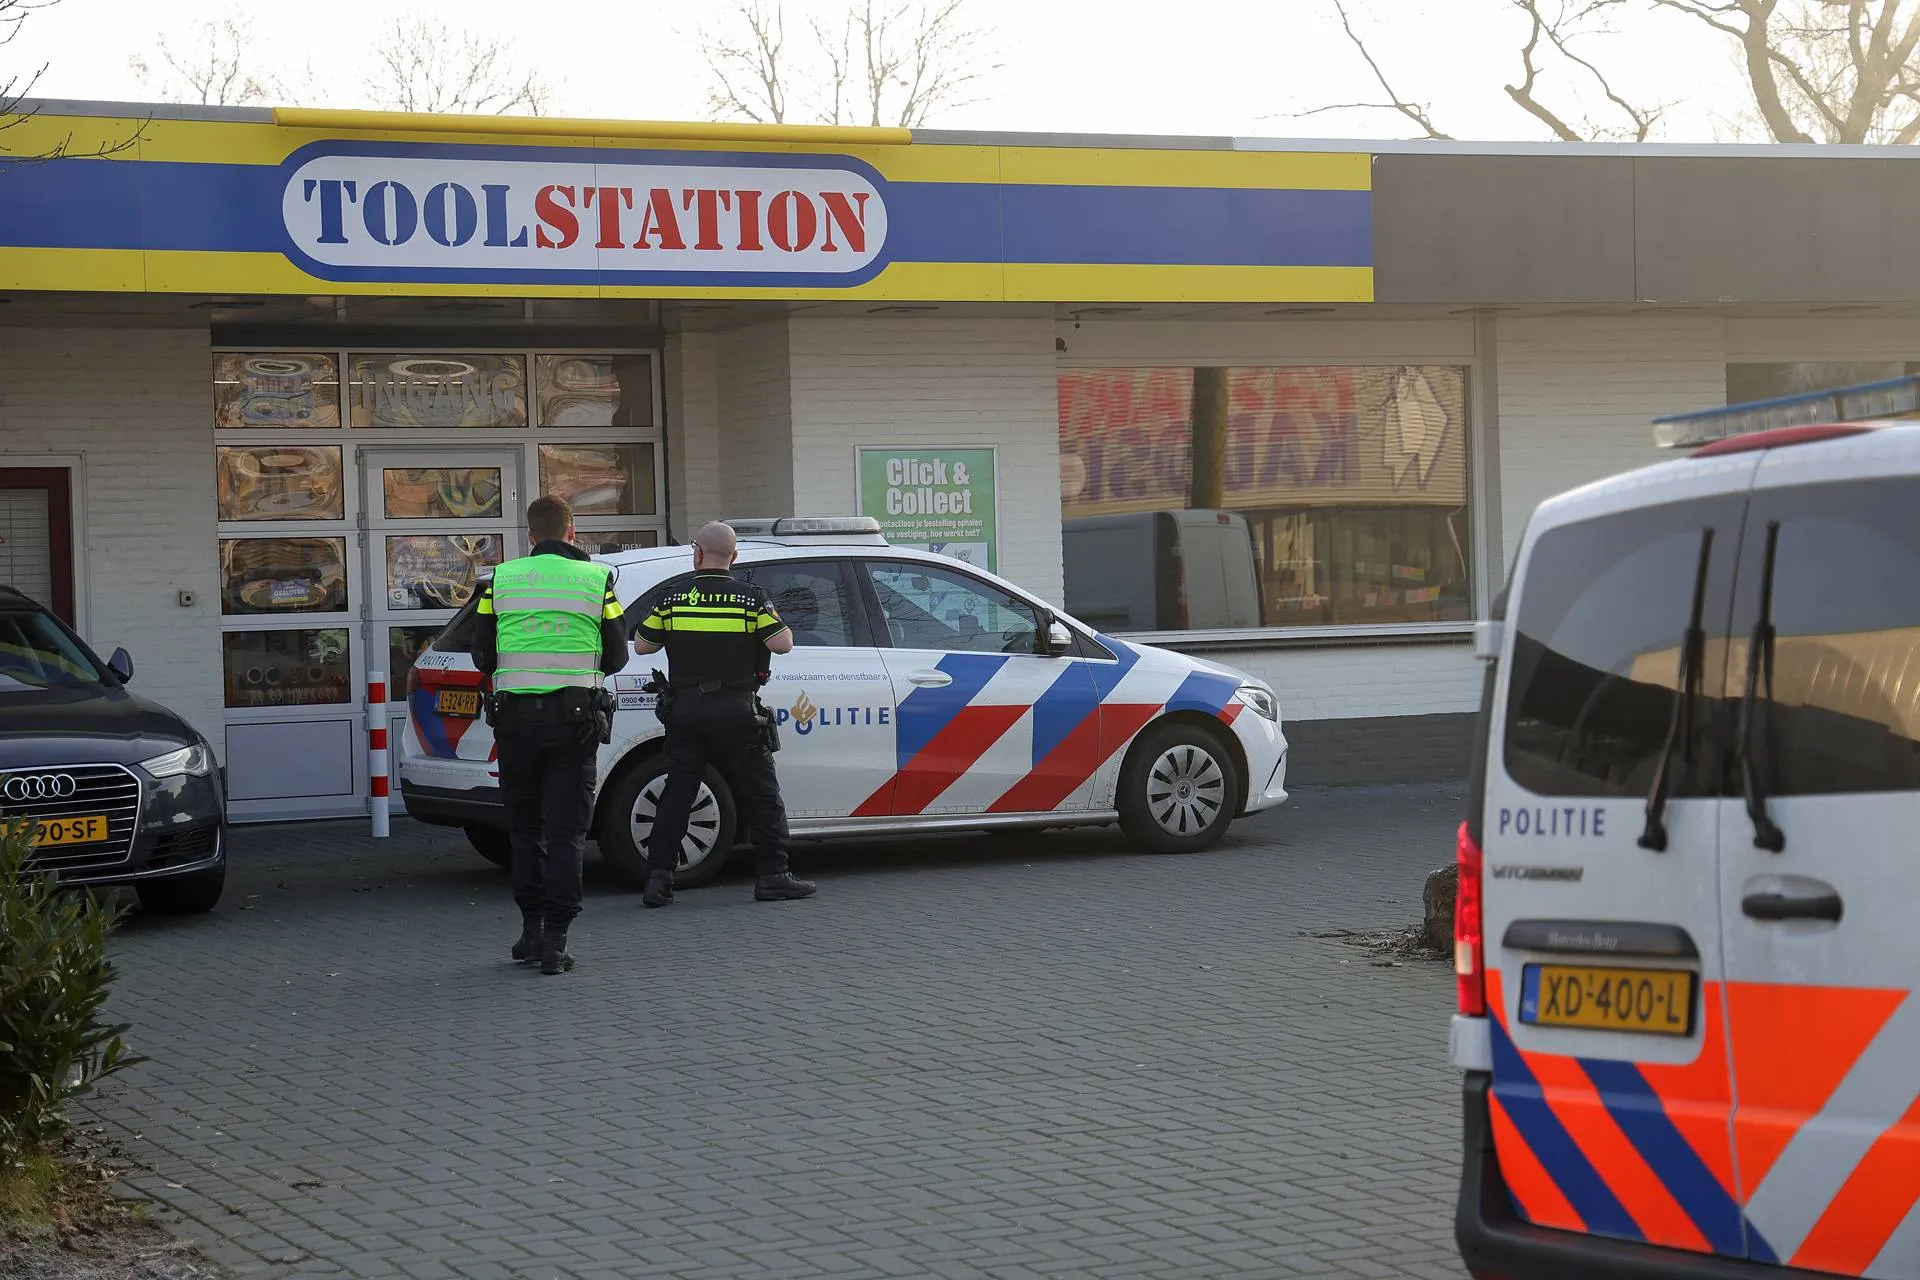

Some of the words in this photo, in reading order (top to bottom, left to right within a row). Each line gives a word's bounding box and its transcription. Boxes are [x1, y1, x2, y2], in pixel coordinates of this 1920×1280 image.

[303, 178, 870, 254] TOOLSTATION
[362, 373, 516, 410] INGANG
[886, 457, 948, 486] Click
[953, 461, 969, 485] &
[886, 487, 972, 515] Collect
[838, 672, 880, 680] dienstbaar
[776, 702, 889, 735] POLITIE
[1500, 808, 1606, 837] POLITIE
[1545, 974, 1681, 1024] XD-400-L
